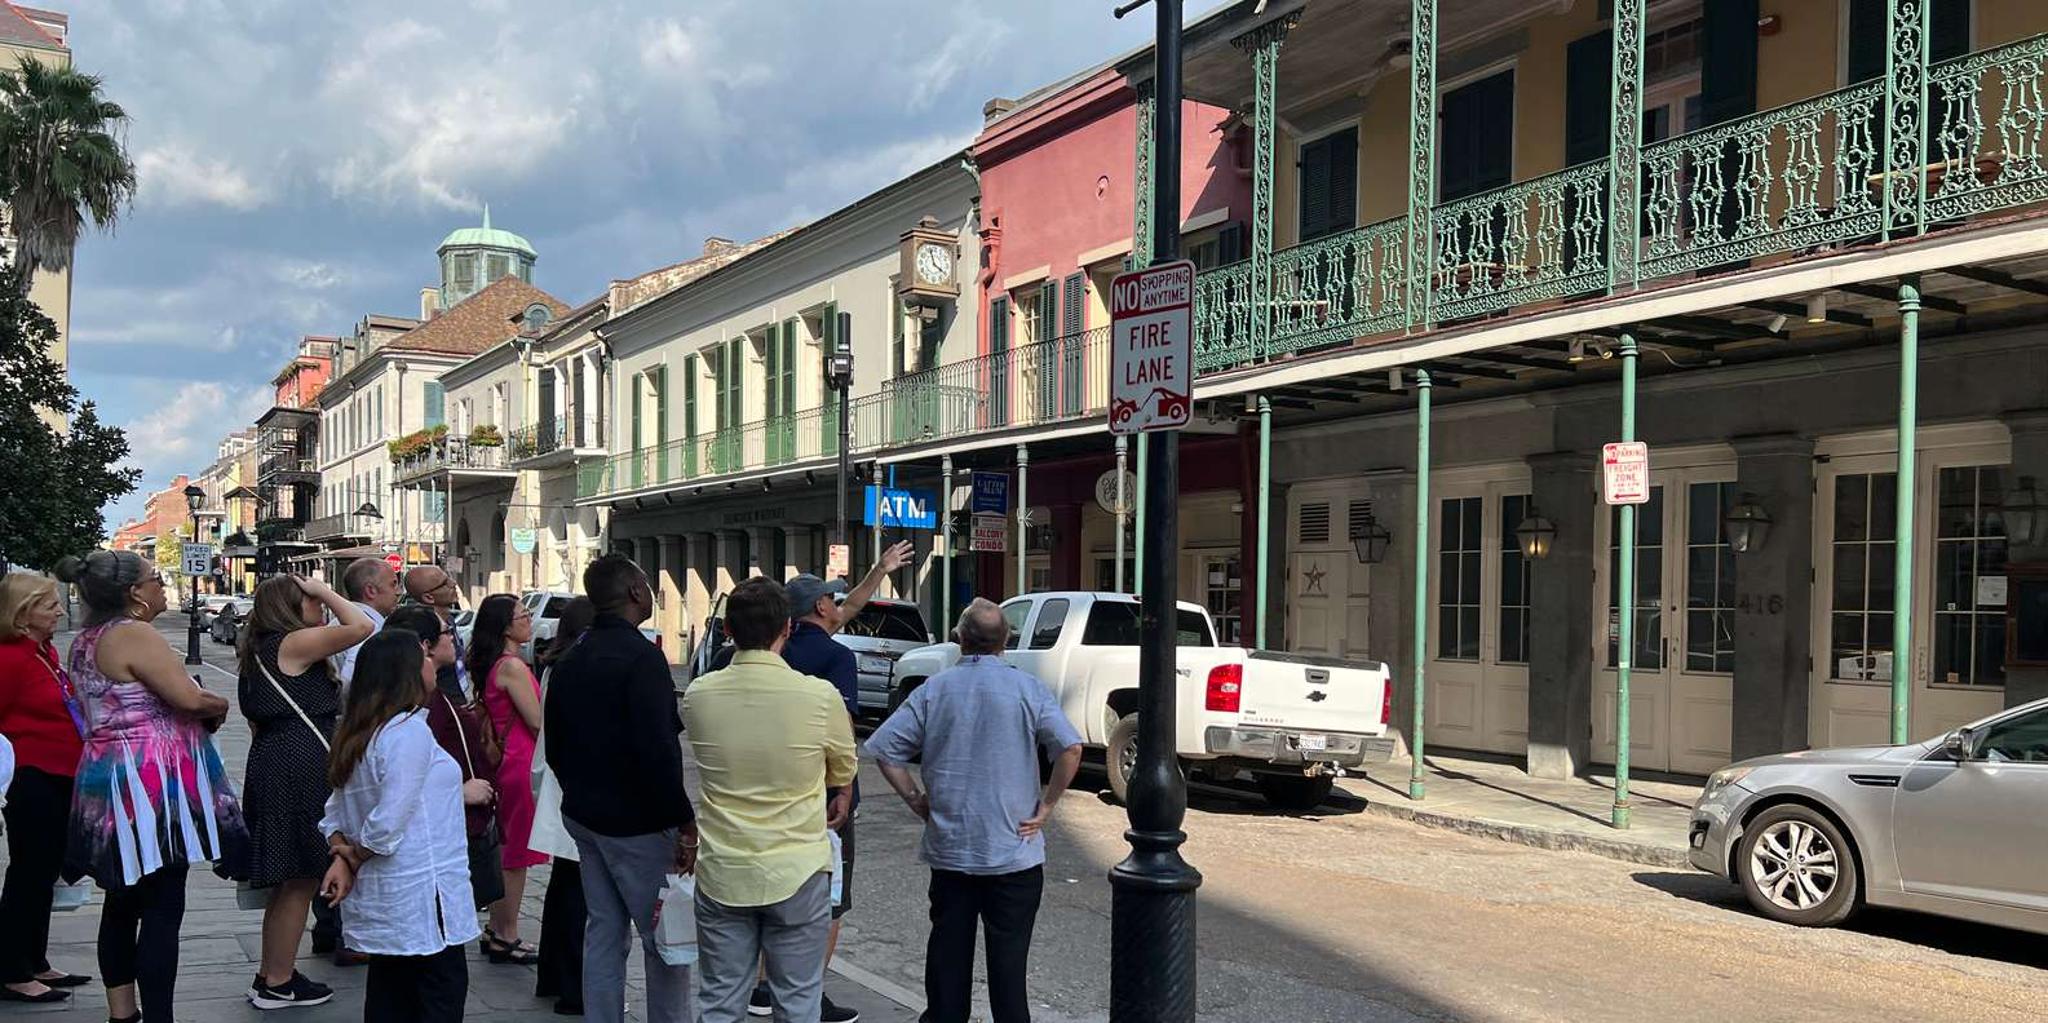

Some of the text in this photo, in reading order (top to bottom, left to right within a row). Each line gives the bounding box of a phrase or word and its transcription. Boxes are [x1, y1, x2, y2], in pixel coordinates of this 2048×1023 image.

[1141, 269, 1189, 291] STOPPING
[1114, 281, 1138, 312] NO
[1144, 287, 1185, 308] ANYTIME
[1130, 321, 1171, 351] FIRE
[1126, 355, 1174, 386] LANE
[1617, 450, 1645, 458] PARKING
[1609, 463, 1642, 473] FREIGHT
[1615, 473, 1636, 482] ZONE
[880, 496, 926, 519] ATM
[184, 545, 209, 553] SPEED
[975, 540, 1004, 550] CONDO
[187, 560, 205, 572] 15
[1738, 593, 1784, 616] 416
